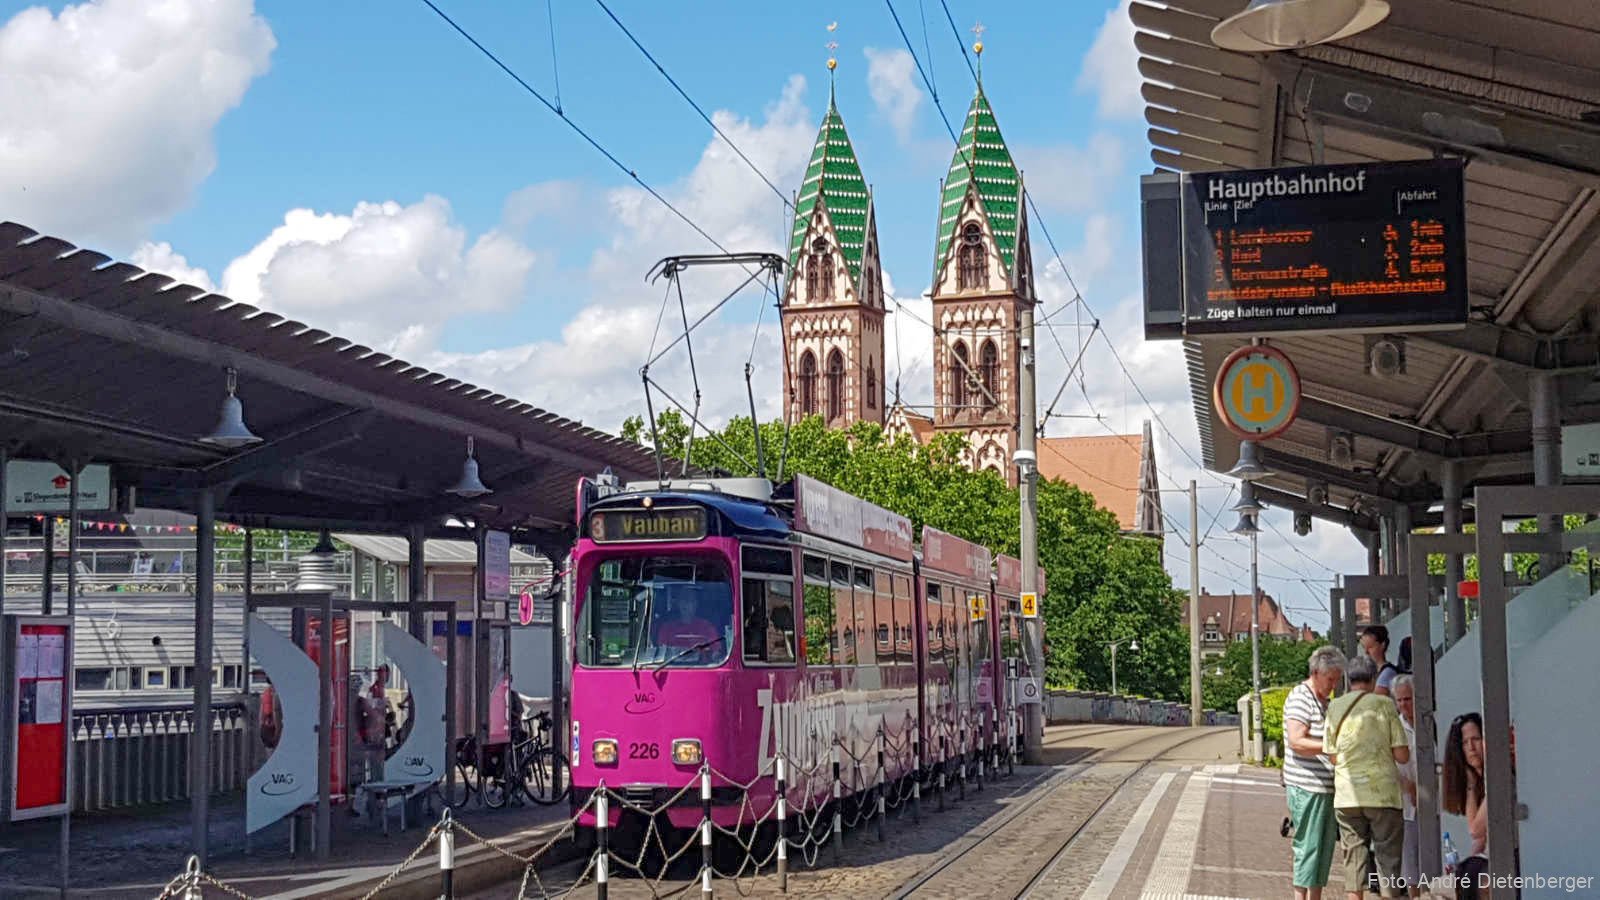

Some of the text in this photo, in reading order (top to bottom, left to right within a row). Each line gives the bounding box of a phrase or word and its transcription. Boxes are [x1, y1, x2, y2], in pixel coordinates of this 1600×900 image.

[1208, 170, 1366, 201] Hauptbahnhof
[1207, 189, 1437, 212] Linie Ziel Abfahrt
[1206, 303, 1336, 321] Züge halten nur einmal
[1242, 372, 1274, 415] H
[592, 513, 697, 539] 3 Vauban
[1024, 598, 1033, 613] 4
[634, 692, 656, 703] VAG
[629, 742, 660, 760] 226
[271, 773, 294, 785] VAG
